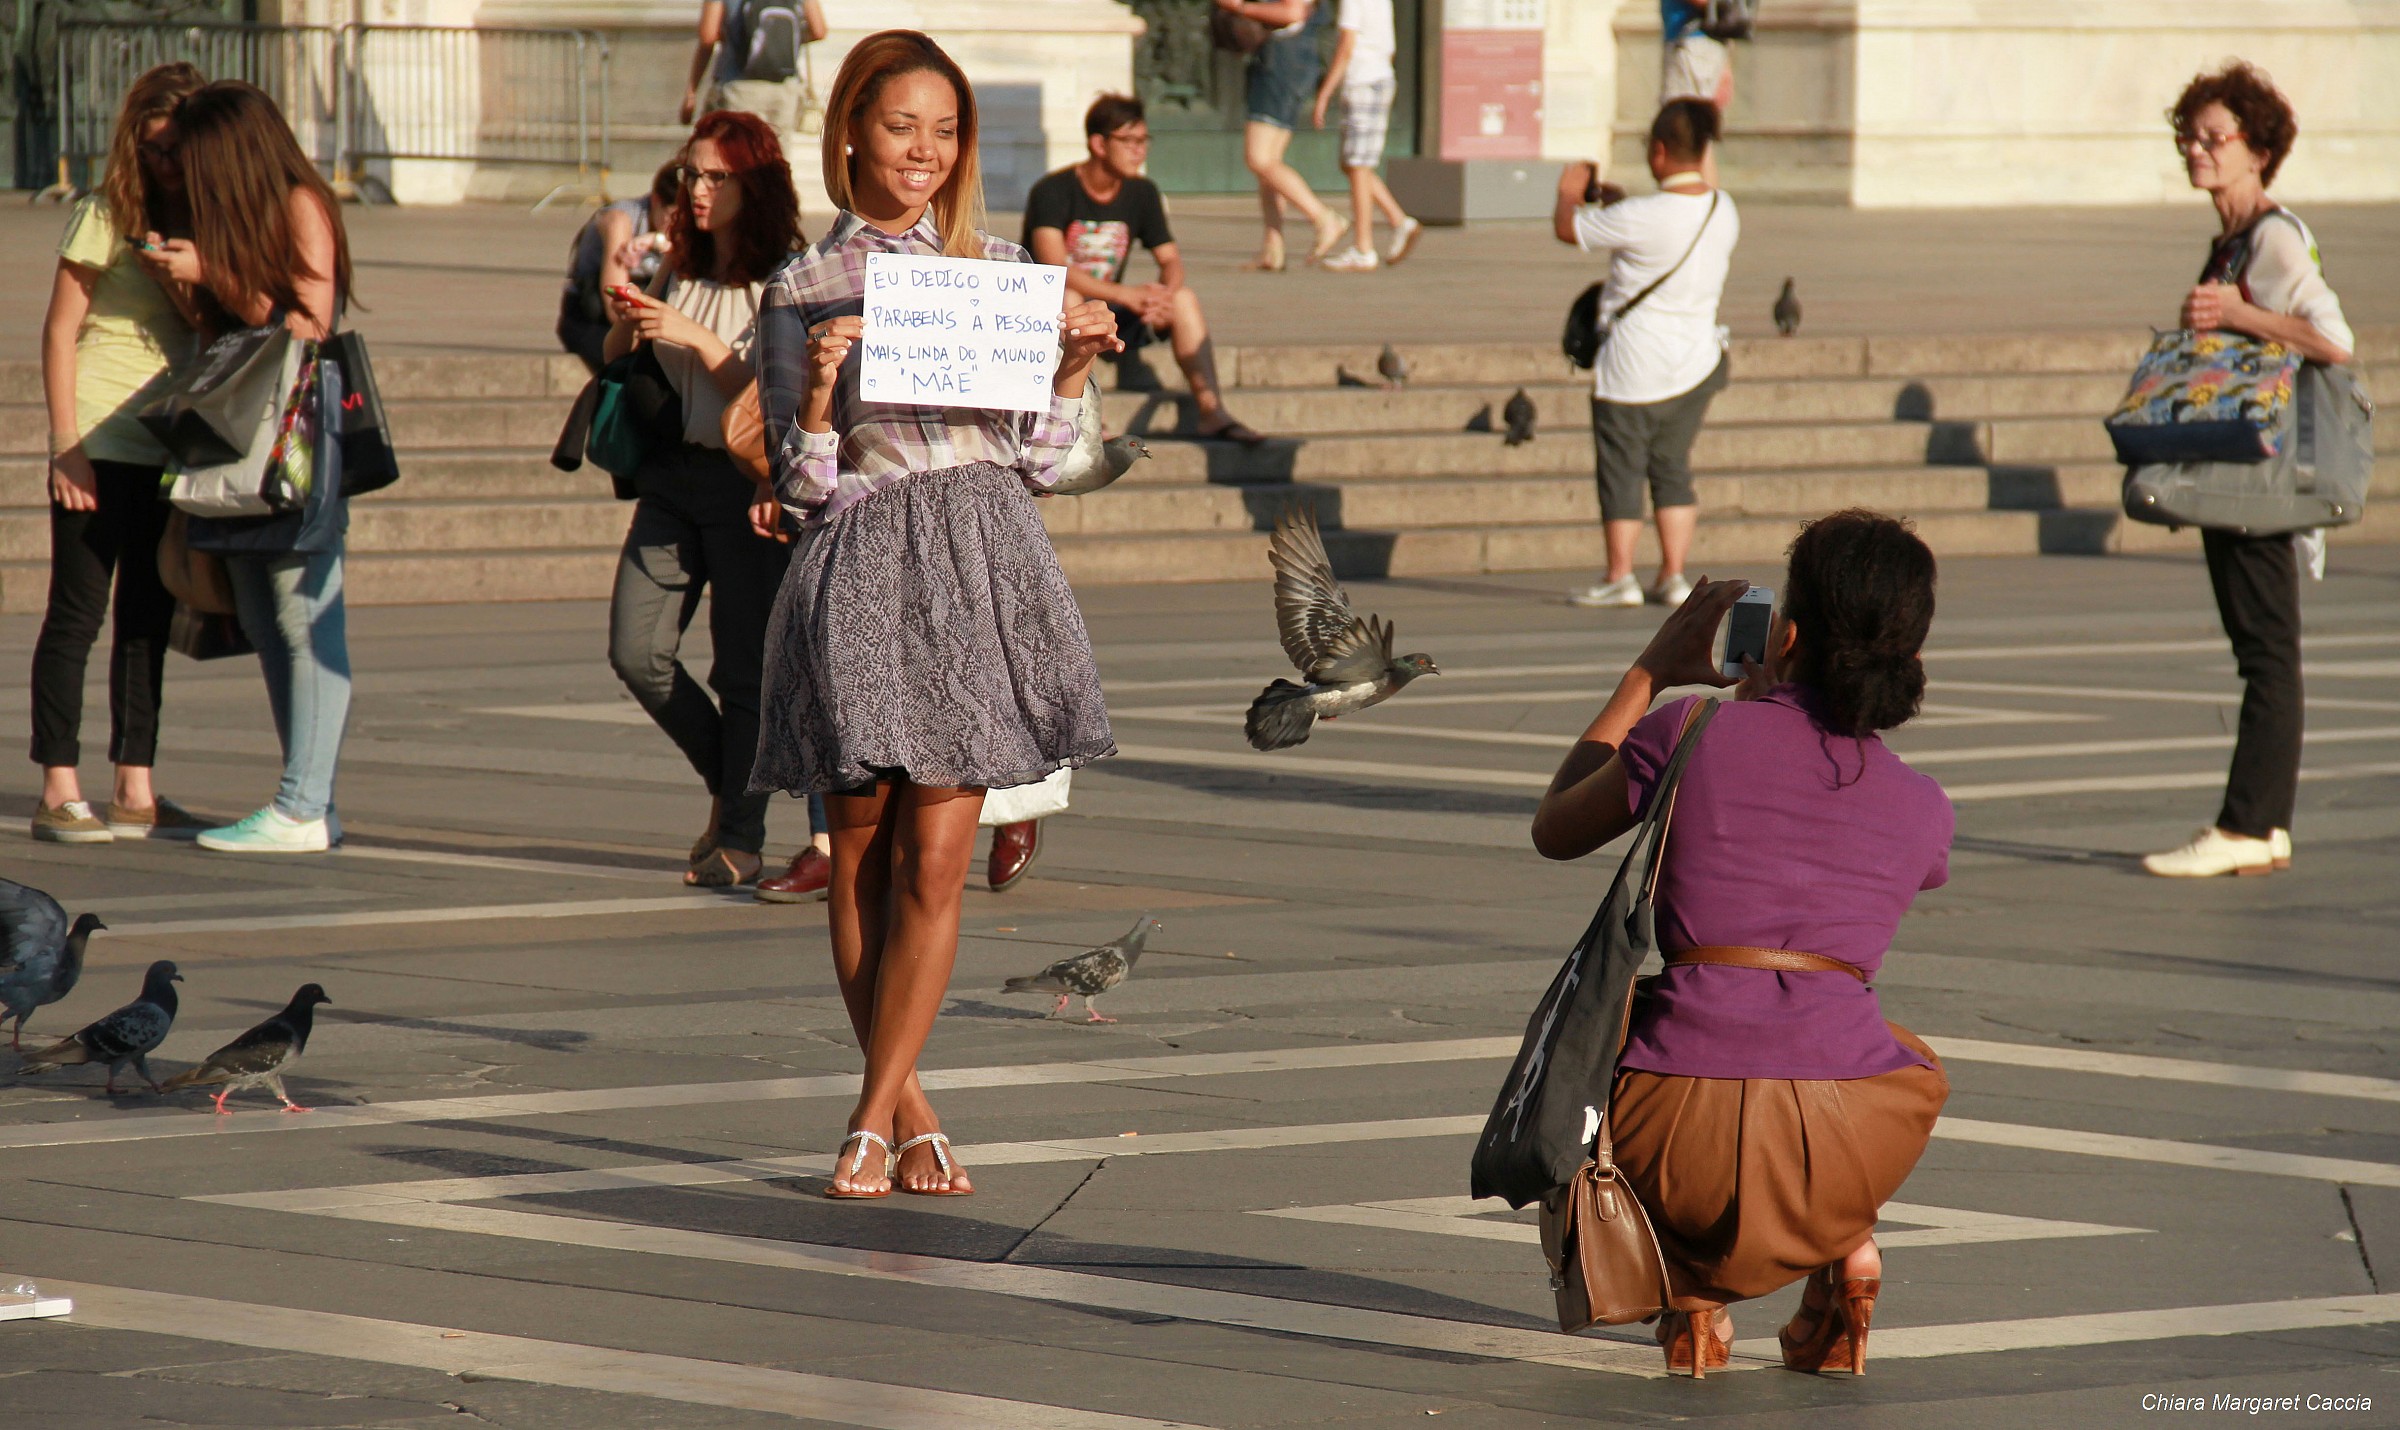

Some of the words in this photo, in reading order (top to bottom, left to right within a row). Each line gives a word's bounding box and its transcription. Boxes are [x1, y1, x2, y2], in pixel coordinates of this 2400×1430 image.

[873, 271, 899, 290] EU
[997, 276, 1028, 294] UM
[871, 306, 957, 330] PARABENS
[972, 315, 983, 331] A
[995, 313, 1053, 334] PESSOA
[865, 343, 901, 362] MAIS
[908, 345, 949, 362] LINDA
[958, 345, 977, 362] DO
[991, 348, 1047, 365] MUNDO
